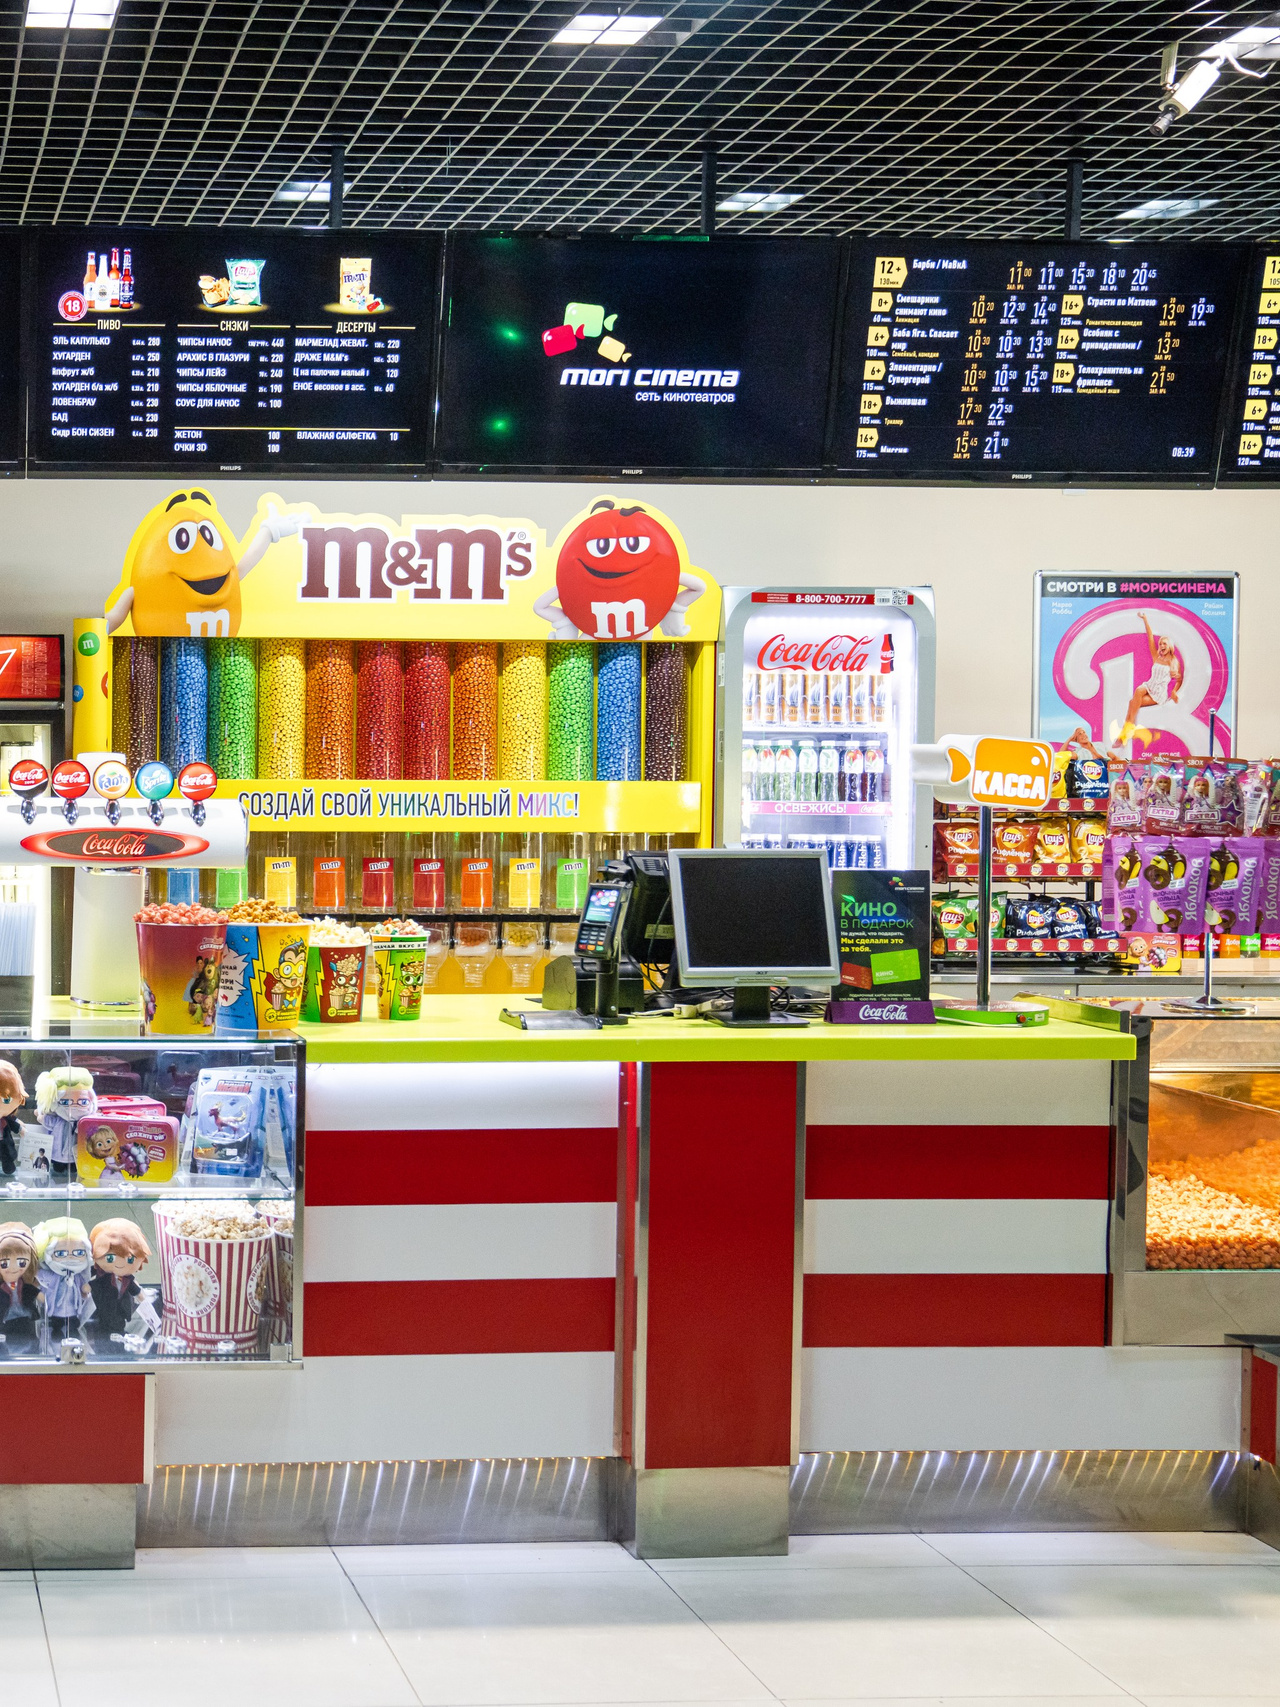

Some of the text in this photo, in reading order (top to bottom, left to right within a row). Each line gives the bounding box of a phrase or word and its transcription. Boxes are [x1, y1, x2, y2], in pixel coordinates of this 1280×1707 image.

[97, 320, 121, 330] ПИВО
[220, 320, 249, 332] СНЭКИ
[336, 322, 376, 334] ДЕСЕРТЫ
[53, 336, 110, 346] ЭЛЬ КАПУЛЬКО
[178, 337, 232, 347] ЧИПСЫ НАЧОС
[295, 338, 339, 348] МАРМЕЛАД
[387, 340, 400, 348] 220
[52, 352, 91, 362] ХУГАРДЕН
[177, 352, 208, 362] АРАХИС
[215, 353, 250, 362] ГЛАЗУРИ
[294, 352, 322, 362] ДРАЖЕ
[176, 366, 227, 377] ЧИПСЫ ЛЕЙЗ
[560, 368, 740, 388] mori cinema
[205, 383, 248, 392] ЯБЛОЧНЫЕ
[52, 397, 97, 406] ЛОВЕНБРАУ
[635, 392, 736, 405] сеть кинотеатров
[52, 412, 68, 422] БАД
[52, 428, 115, 438] Сидр БОН СИЗЕН
[174, 430, 202, 439] ЖЕТОН
[297, 431, 377, 440] ВЛАЖНАЯ САЛФЕТКА
[174, 442, 208, 452] ОЧКИ 3D
[1172, 447, 1196, 458] 08:39
[1046, 581, 1226, 594] СМОТРИ В #МОРИСИНЕМА
[795, 594, 866, 604] 8-800-700-7777
[756, 634, 876, 672] Coca-Cola
[12, 768, 43, 782] Coca-Cola
[54, 771, 86, 784] Coca-Cola
[144, 773, 168, 788] Sprite
[181, 774, 214, 786] Coca-Cola
[98, 773, 129, 790] Fanta
[972, 770, 1046, 800] КАССА
[321, 788, 372, 816] СВОЙ
[378, 788, 511, 817] УНИКАЛЬНЫЙ
[518, 792, 580, 816] МИКС!
[774, 804, 847, 814] ОСВЕЖИСЬ!
[1152, 808, 1175, 816] EXTRA
[1112, 814, 1137, 822] EXTRA
[1188, 812, 1216, 820] EXTRA
[82, 834, 148, 856] Coca-Cola
[858, 846, 866, 868] Rich
[1184, 858, 1204, 921] Яблоков
[1238, 858, 1258, 922] Яблоков
[840, 902, 898, 917] КИНО
[840, 918, 914, 930] В ПОДАРОК
[858, 1004, 908, 1020] Coca-Cola
[193, 1258, 218, 1284] POPCORN
